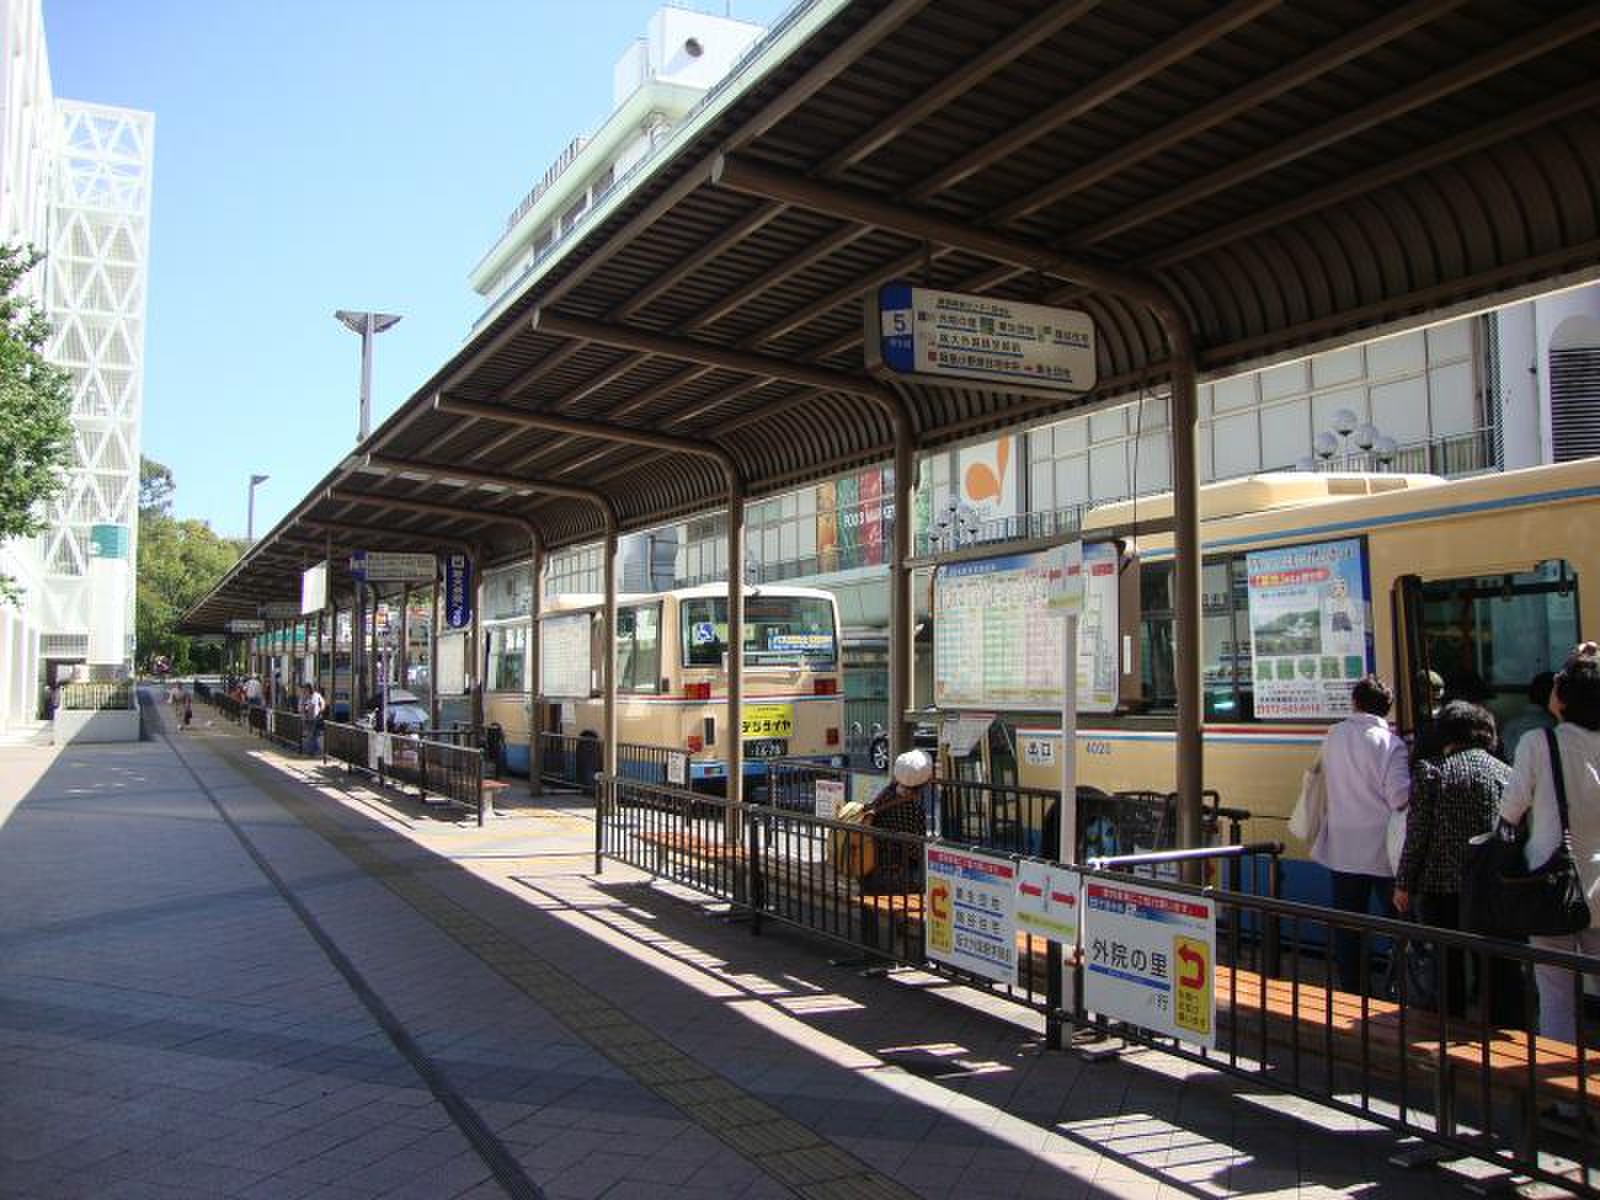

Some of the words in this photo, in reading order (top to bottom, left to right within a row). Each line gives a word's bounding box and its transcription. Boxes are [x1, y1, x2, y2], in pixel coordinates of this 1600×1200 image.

[894, 313, 906, 332] 5
[1092, 938, 1169, 979] 外院の里
